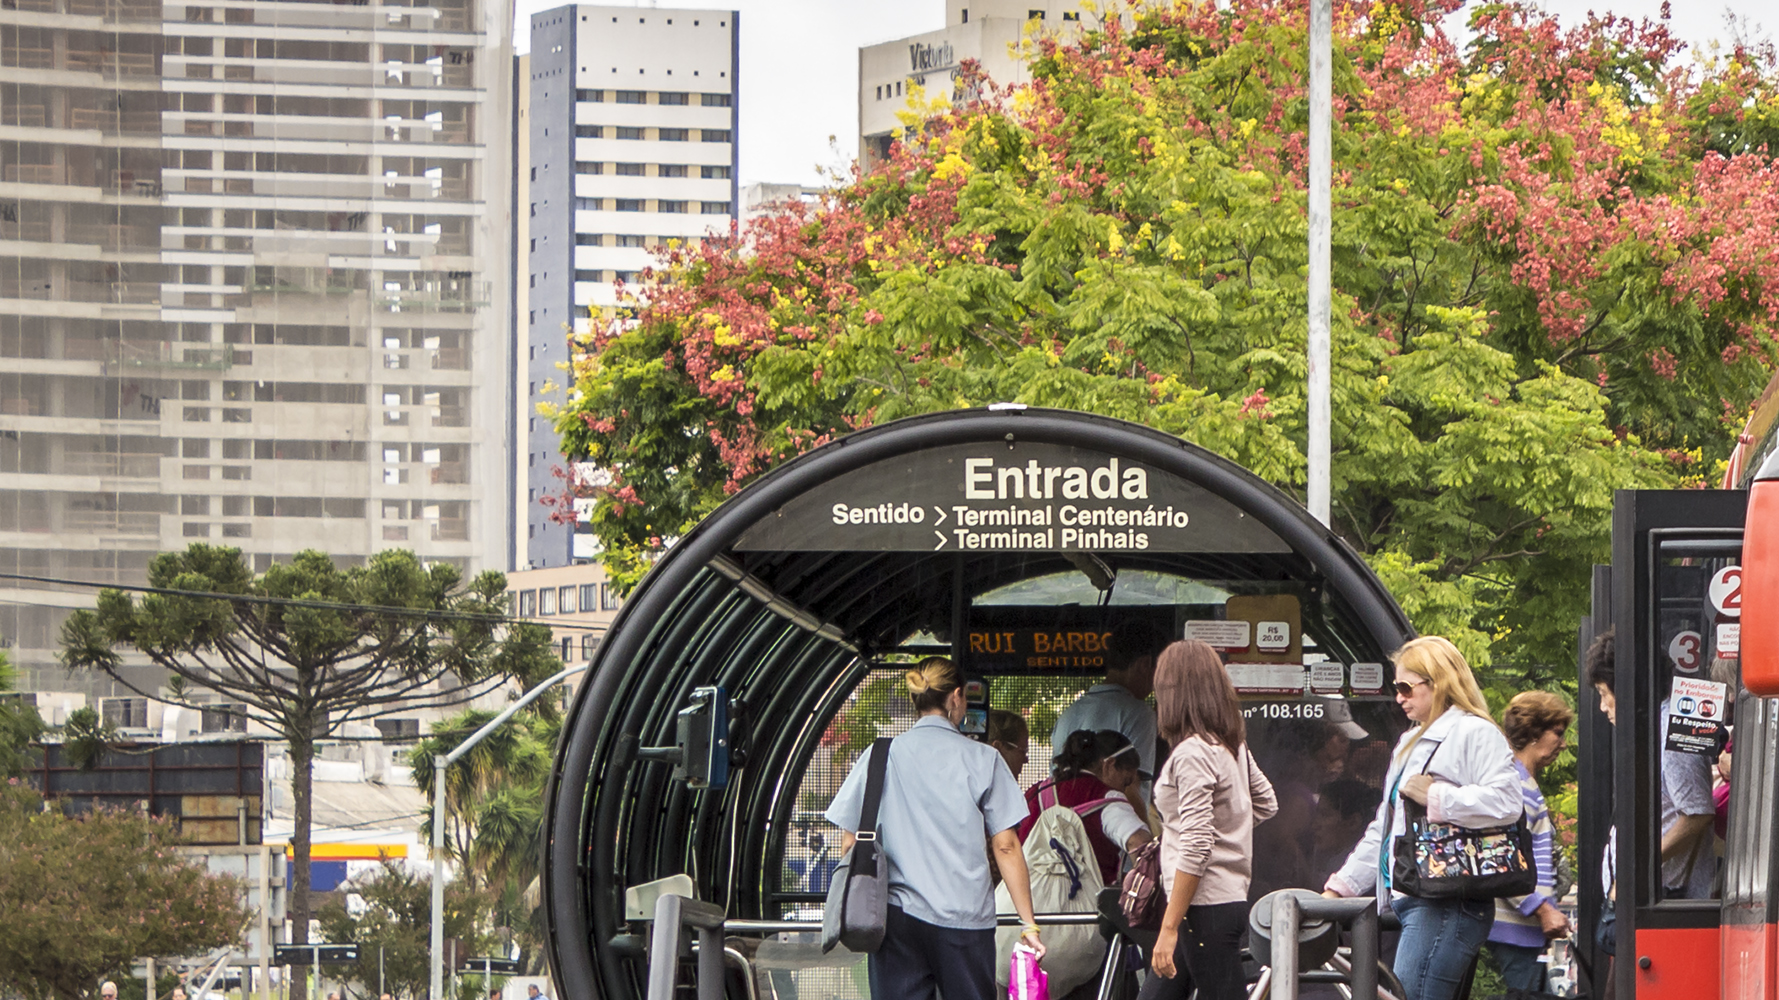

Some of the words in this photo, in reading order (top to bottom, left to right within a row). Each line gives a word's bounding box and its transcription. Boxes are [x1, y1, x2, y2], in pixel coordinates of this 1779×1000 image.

[964, 457, 1149, 500] Entrada
[832, 503, 925, 525] Sentido
[952, 505, 1052, 527] Terminal
[1059, 505, 1189, 528] Centenário
[953, 529, 1054, 549] Terminal
[1061, 529, 1150, 550] Pinhais
[1721, 569, 1742, 609] 2
[969, 632, 1016, 654] RUI
[1033, 632, 1113, 653] BARBO
[1677, 634, 1701, 670] 3
[1026, 656, 1104, 667] SENTIDO
[1260, 703, 1324, 719] 108.165
